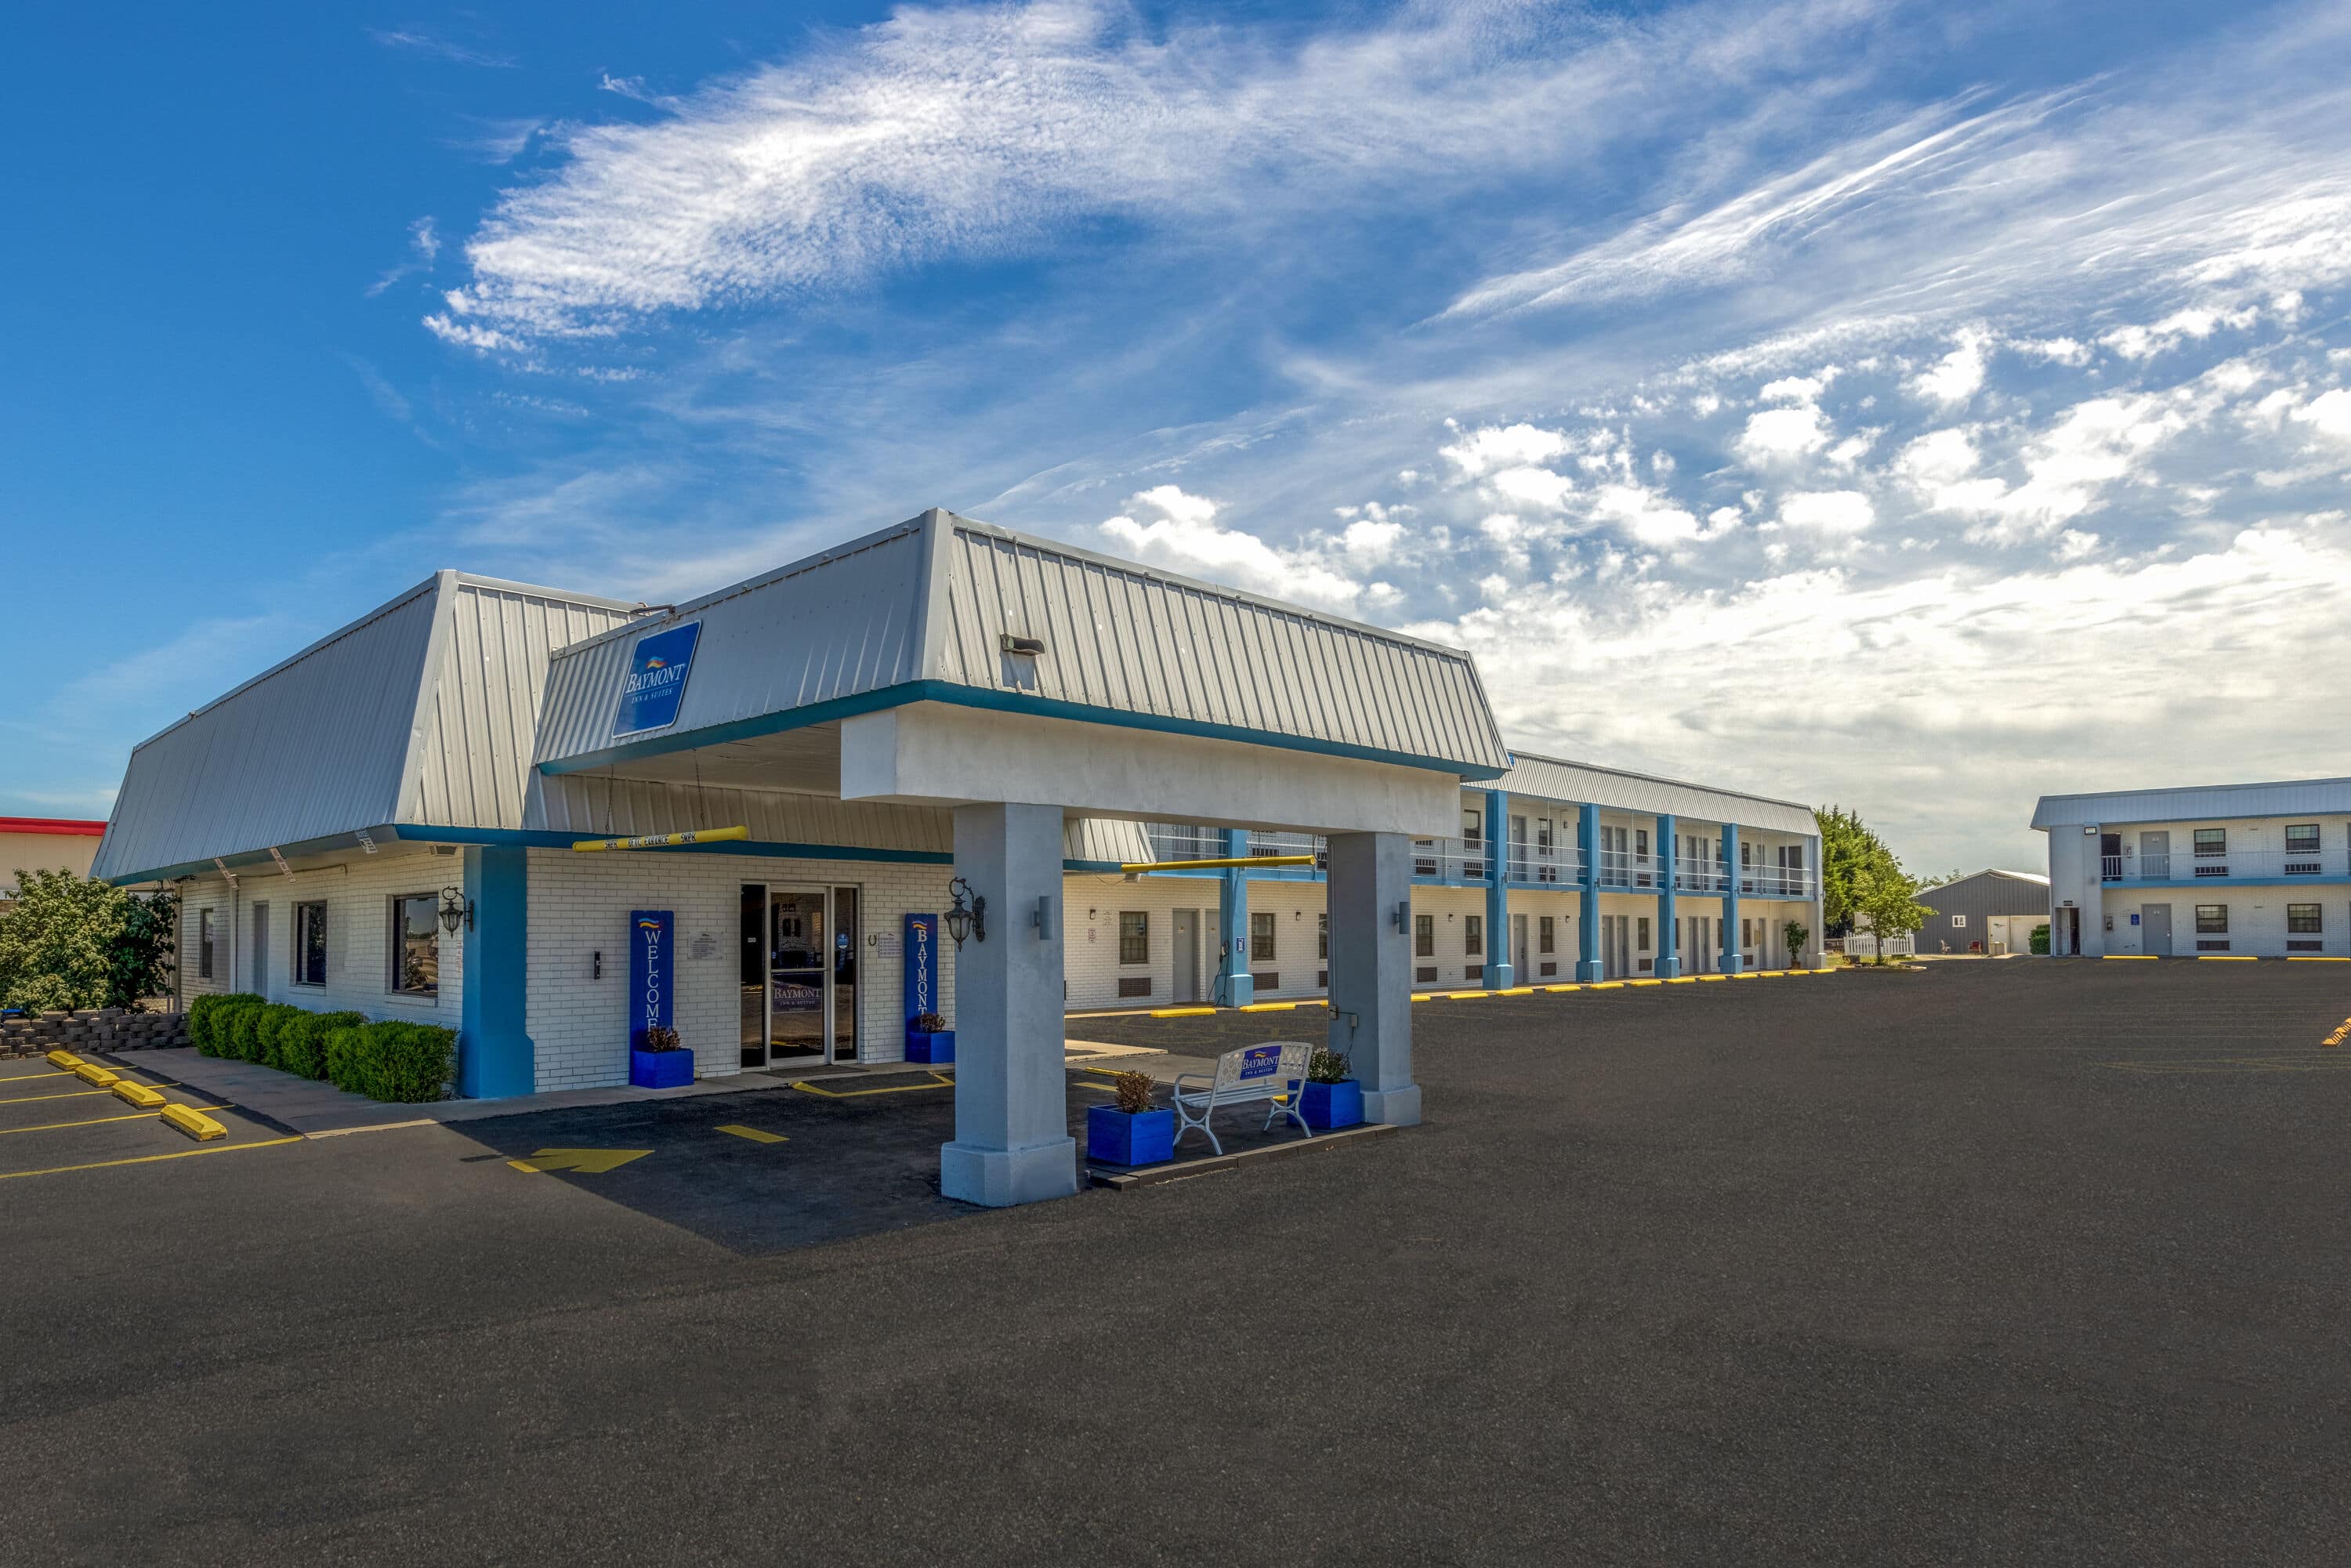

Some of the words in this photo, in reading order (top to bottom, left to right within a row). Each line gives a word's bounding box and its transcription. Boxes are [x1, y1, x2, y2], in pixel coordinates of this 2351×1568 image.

[625, 663, 685, 693] BAYMONT
[632, 695, 643, 704] INN
[650, 687, 673, 699] SUITES
[645, 930, 661, 1032] WELCOME
[918, 929, 928, 1016] BAYMONT
[774, 988, 820, 999] BAYMONT
[1242, 1056, 1279, 1070] BAYMONT
